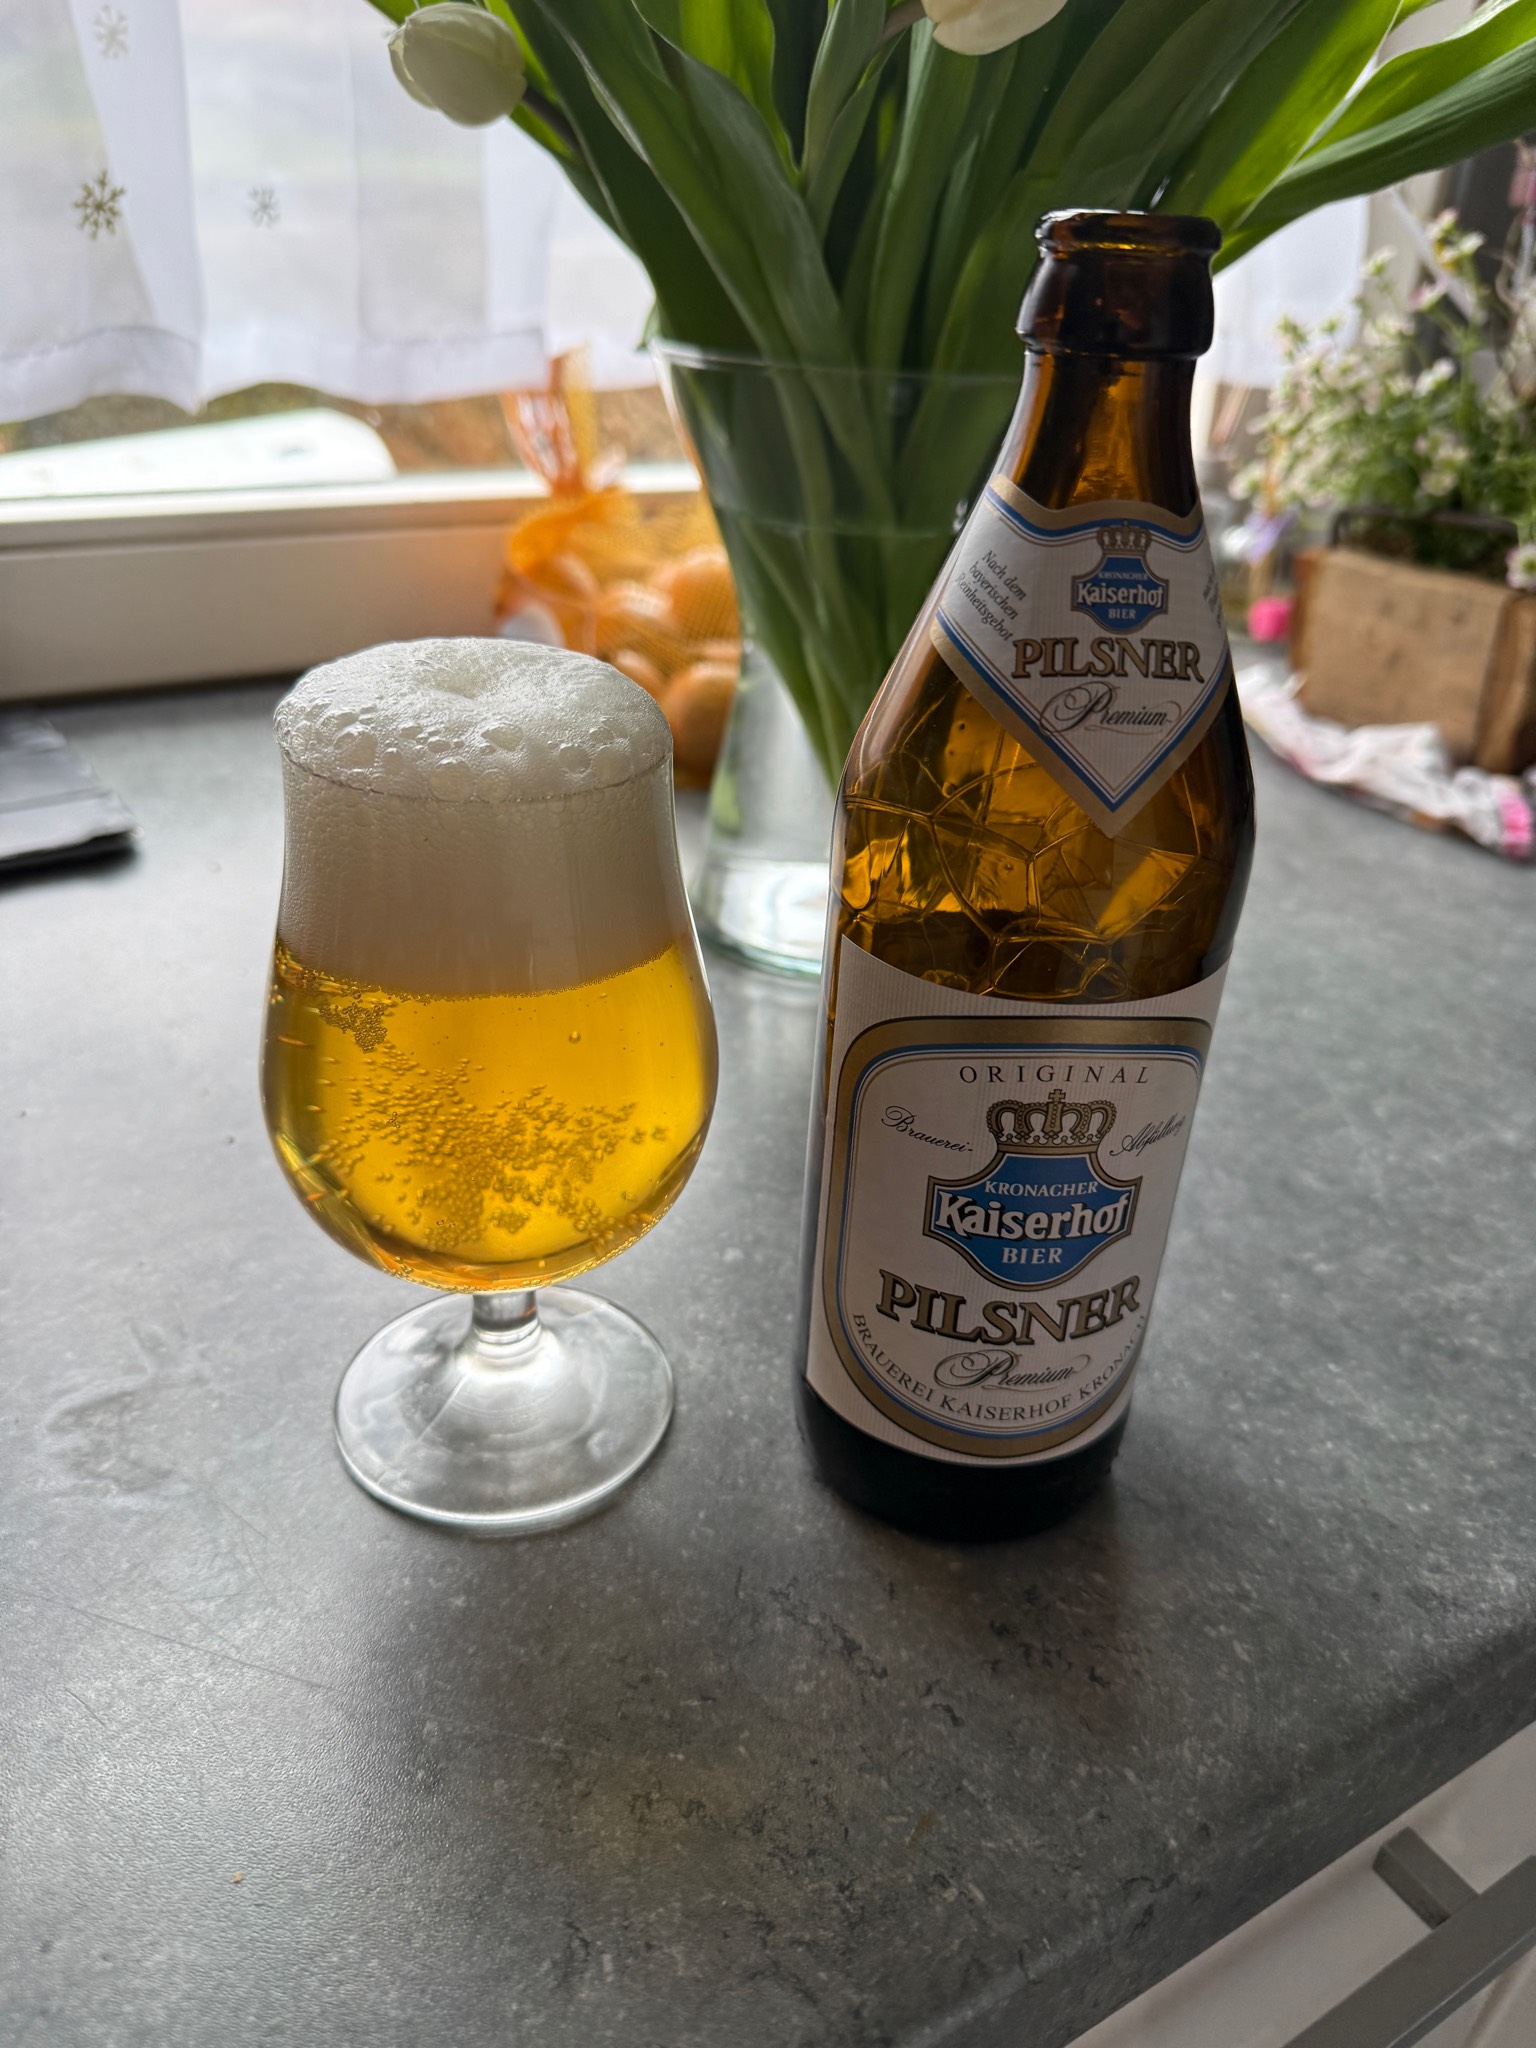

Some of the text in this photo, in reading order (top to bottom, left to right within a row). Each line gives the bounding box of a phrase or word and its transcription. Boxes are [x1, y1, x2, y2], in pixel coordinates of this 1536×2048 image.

[969, 561, 1019, 620] bayerischen
[982, 550, 1027, 601] Nach dem
[1077, 582, 1164, 608] Kaiserhof
[956, 572, 1013, 641] Reinheitsgebot
[1108, 608, 1136, 620] BIER
[1011, 637, 1205, 684] PILSNER
[1038, 681, 1182, 736] Premium
[959, 1065, 1149, 1084] ORIGINAL
[881, 1105, 974, 1153] Brauerei-
[984, 1180, 1099, 1198] KRONACHER
[935, 1190, 1131, 1240] Kaiserhof
[1001, 1247, 1063, 1265] BIER
[876, 1268, 1142, 1346] PILSNER
[852, 1313, 934, 1403] BRAUEREI
[939, 1393, 1074, 1422] KAISERHOF
[933, 1348, 1091, 1393] Premium
